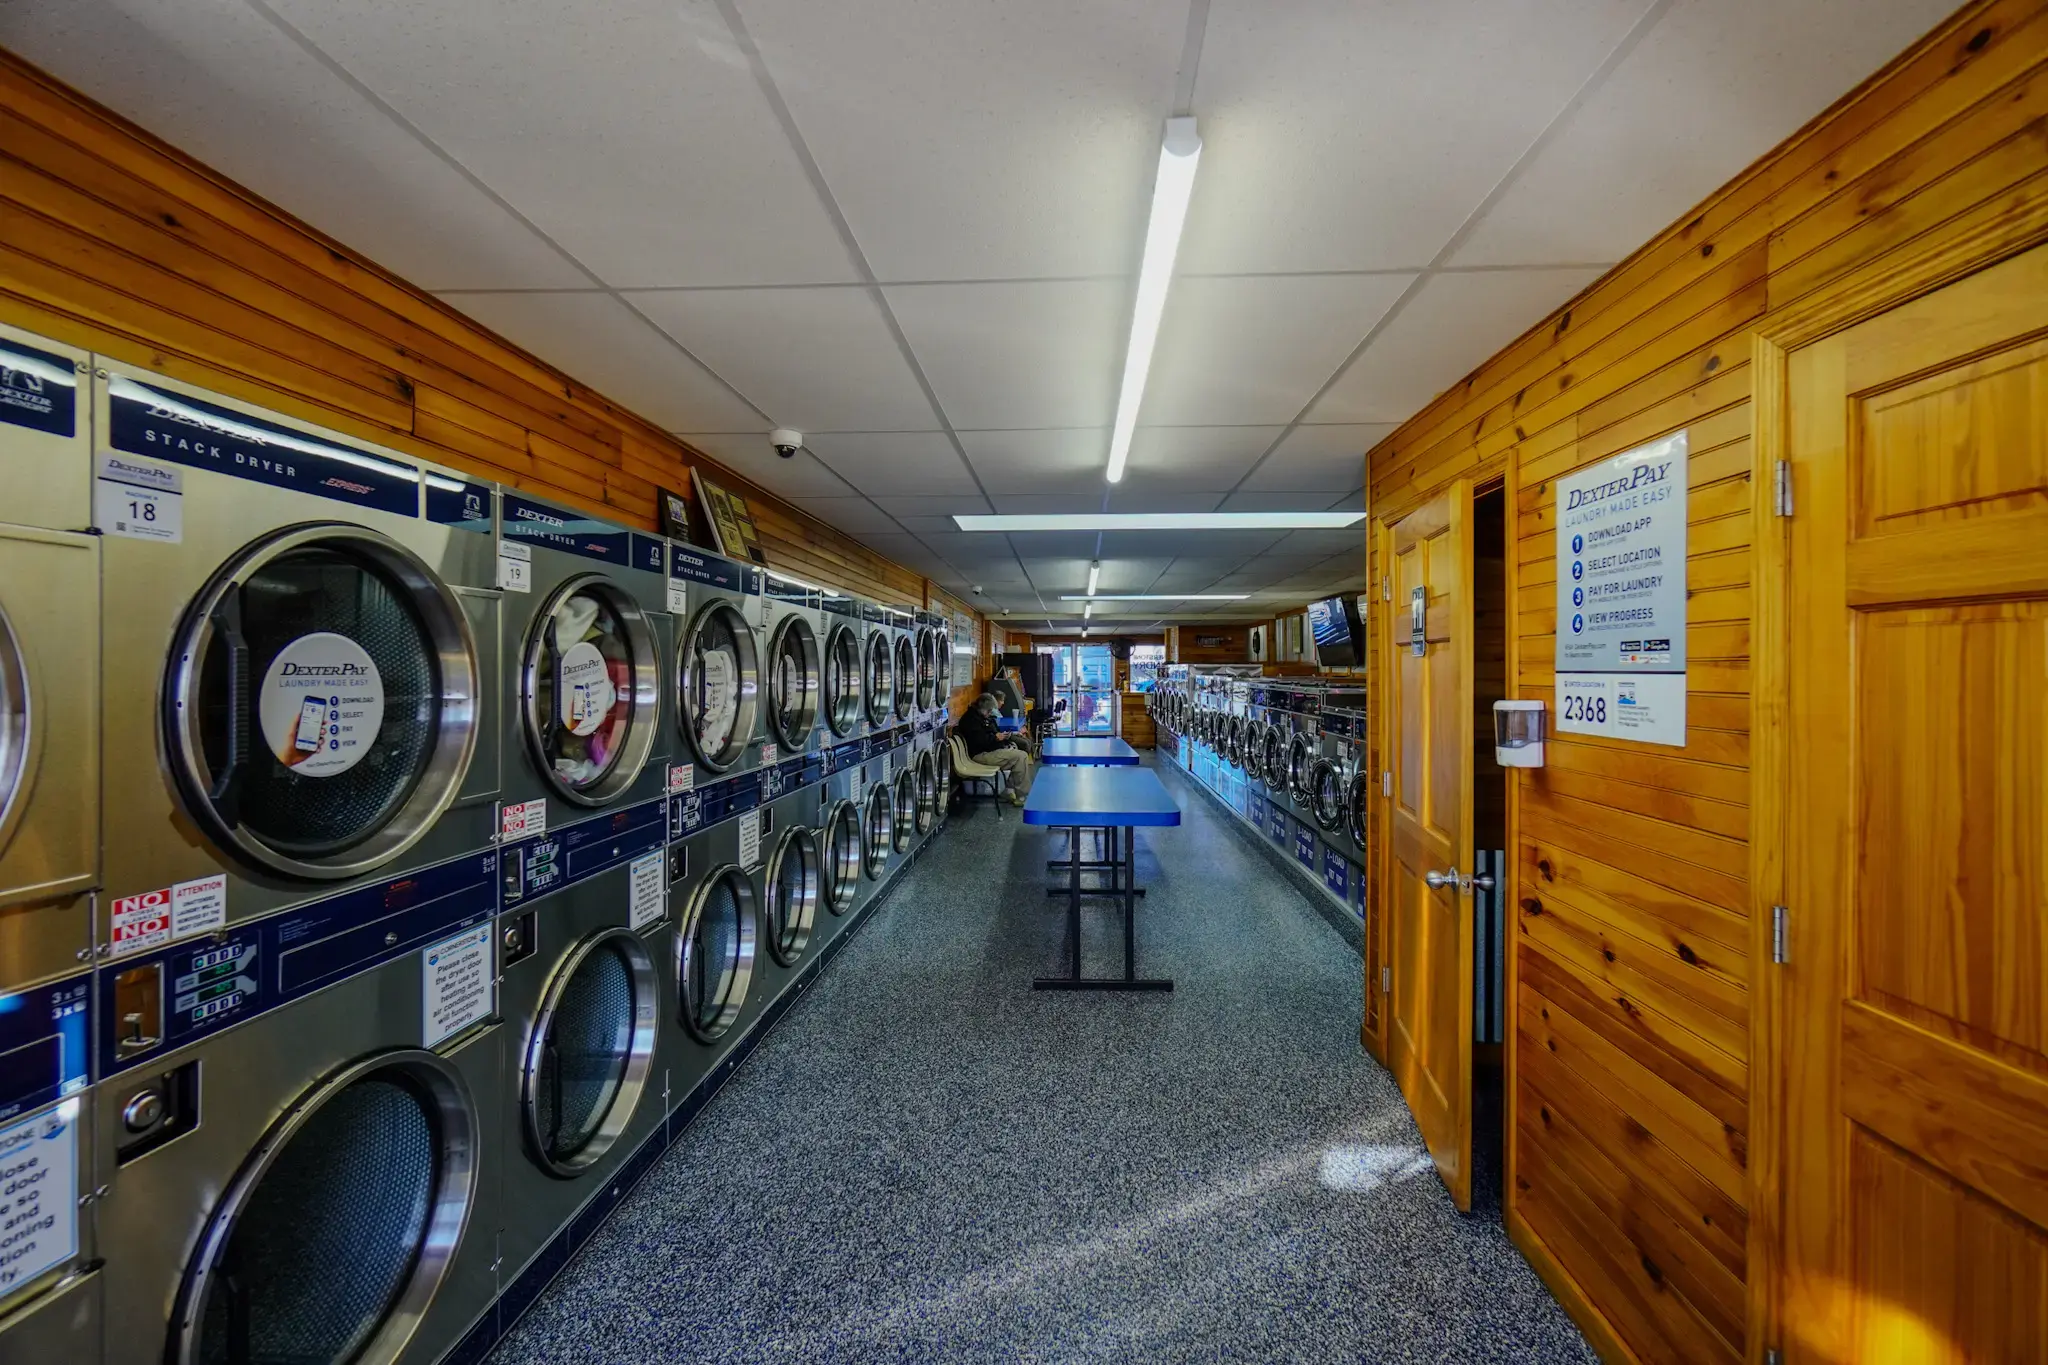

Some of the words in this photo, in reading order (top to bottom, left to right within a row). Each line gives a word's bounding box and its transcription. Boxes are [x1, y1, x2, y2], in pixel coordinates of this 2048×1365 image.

[145, 429, 221, 458] STACK
[235, 452, 296, 477] DRYER
[129, 500, 156, 522] 18
[515, 506, 564, 528] DEXTER
[1565, 506, 1607, 528] LAUNDRY
[1610, 496, 1638, 513] MADE
[1643, 485, 1673, 506] EASY
[515, 524, 545, 539] STACK
[549, 533, 576, 546] DRYER
[1588, 521, 1632, 543] DOWNLOAD
[1633, 516, 1652, 531] APP
[678, 552, 704, 567] DEXTER
[1588, 555, 1617, 571] SELECT
[1618, 546, 1661, 565] LOCATION
[510, 568, 521, 580] 19
[1588, 584, 1603, 597] PAY
[1604, 582, 1620, 594] FOR
[1621, 575, 1664, 592] LAUNDRY
[1588, 612, 1608, 624] VIEW
[1609, 607, 1654, 622] PROGRESS
[279, 679, 321, 688] LAUNDRY
[324, 679, 347, 687] MADE
[350, 679, 369, 687] EASY
[342, 711, 364, 719] SELECT
[1564, 695, 1607, 723] 2368
[506, 804, 523, 816] NO
[506, 821, 523, 832] NO
[1326, 848, 1345, 870] 2-LOAD
[177, 881, 223, 898] ATTENTION
[122, 892, 163, 913] NO
[121, 918, 162, 939] NO
[435, 975, 447, 986] the
[448, 967, 466, 981] dryer
[467, 958, 482, 970] door
[437, 958, 460, 974] Please
[461, 950, 480, 963] close
[440, 980, 457, 993] after
[458, 974, 470, 982] use
[471, 969, 480, 978] so
[440, 985, 466, 1003] heating
[467, 978, 480, 987] and
[432, 1007, 442, 1018] air
[443, 986, 485, 1013] conditioning
[438, 1014, 450, 1025] will
[450, 998, 479, 1017] function
[4, 1167, 50, 1196] door
[17, 1189, 41, 1205] so
[4, 1203, 41, 1231] and
